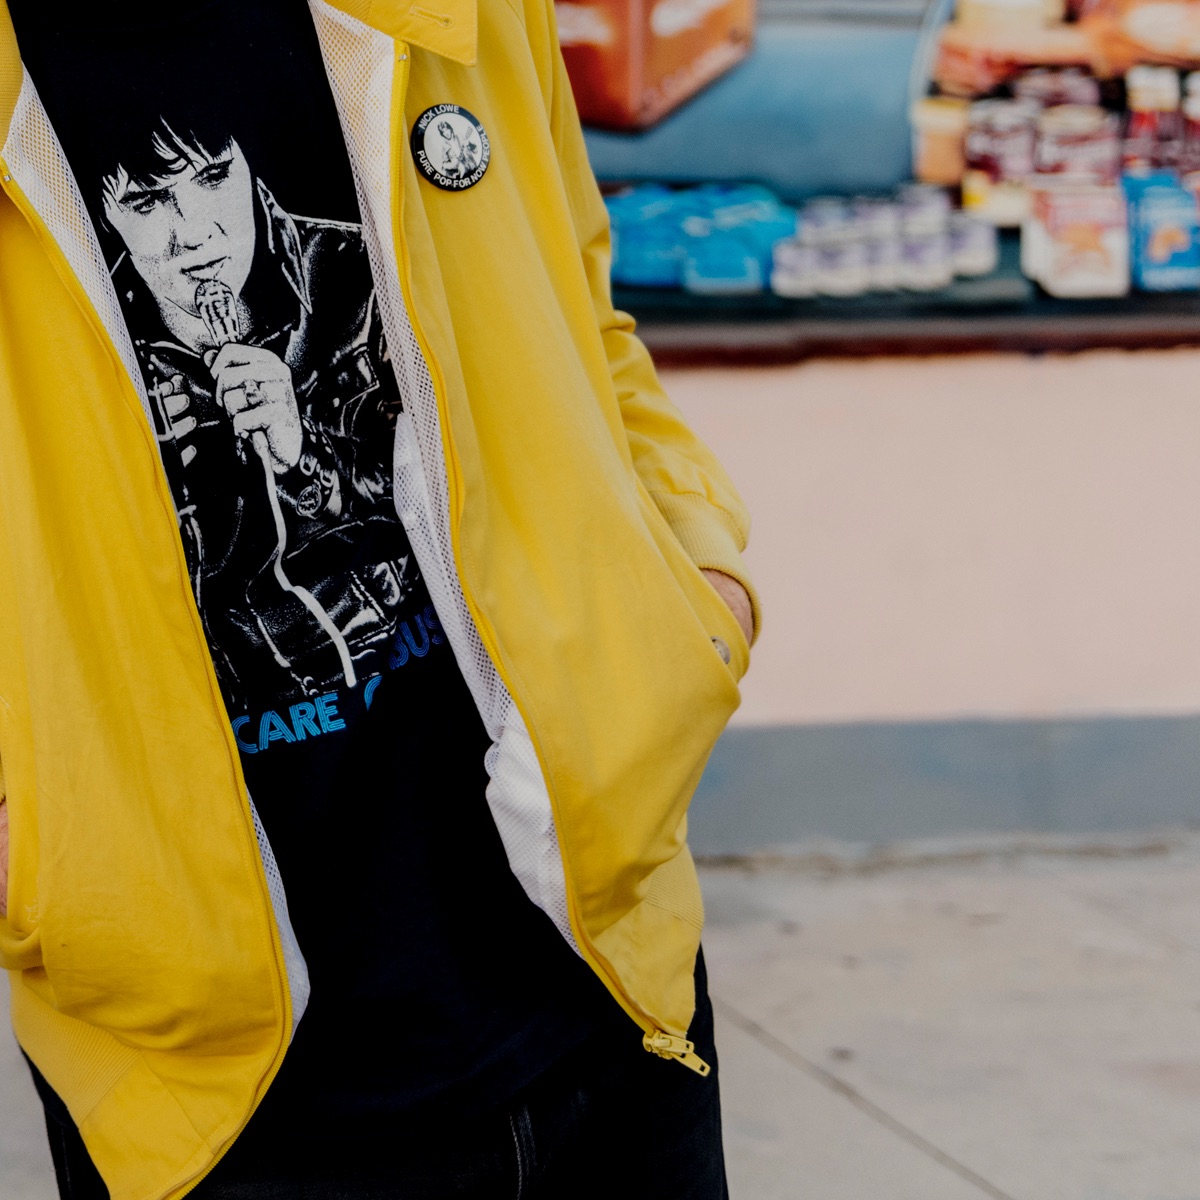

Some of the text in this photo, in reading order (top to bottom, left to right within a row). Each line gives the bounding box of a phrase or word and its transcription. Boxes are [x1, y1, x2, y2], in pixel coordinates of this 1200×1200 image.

[418, 104, 460, 130] NICK LOWE
[417, 124, 490, 189] PURE POP FOR NOW PEOPLE
[231, 692, 346, 754] CARE
